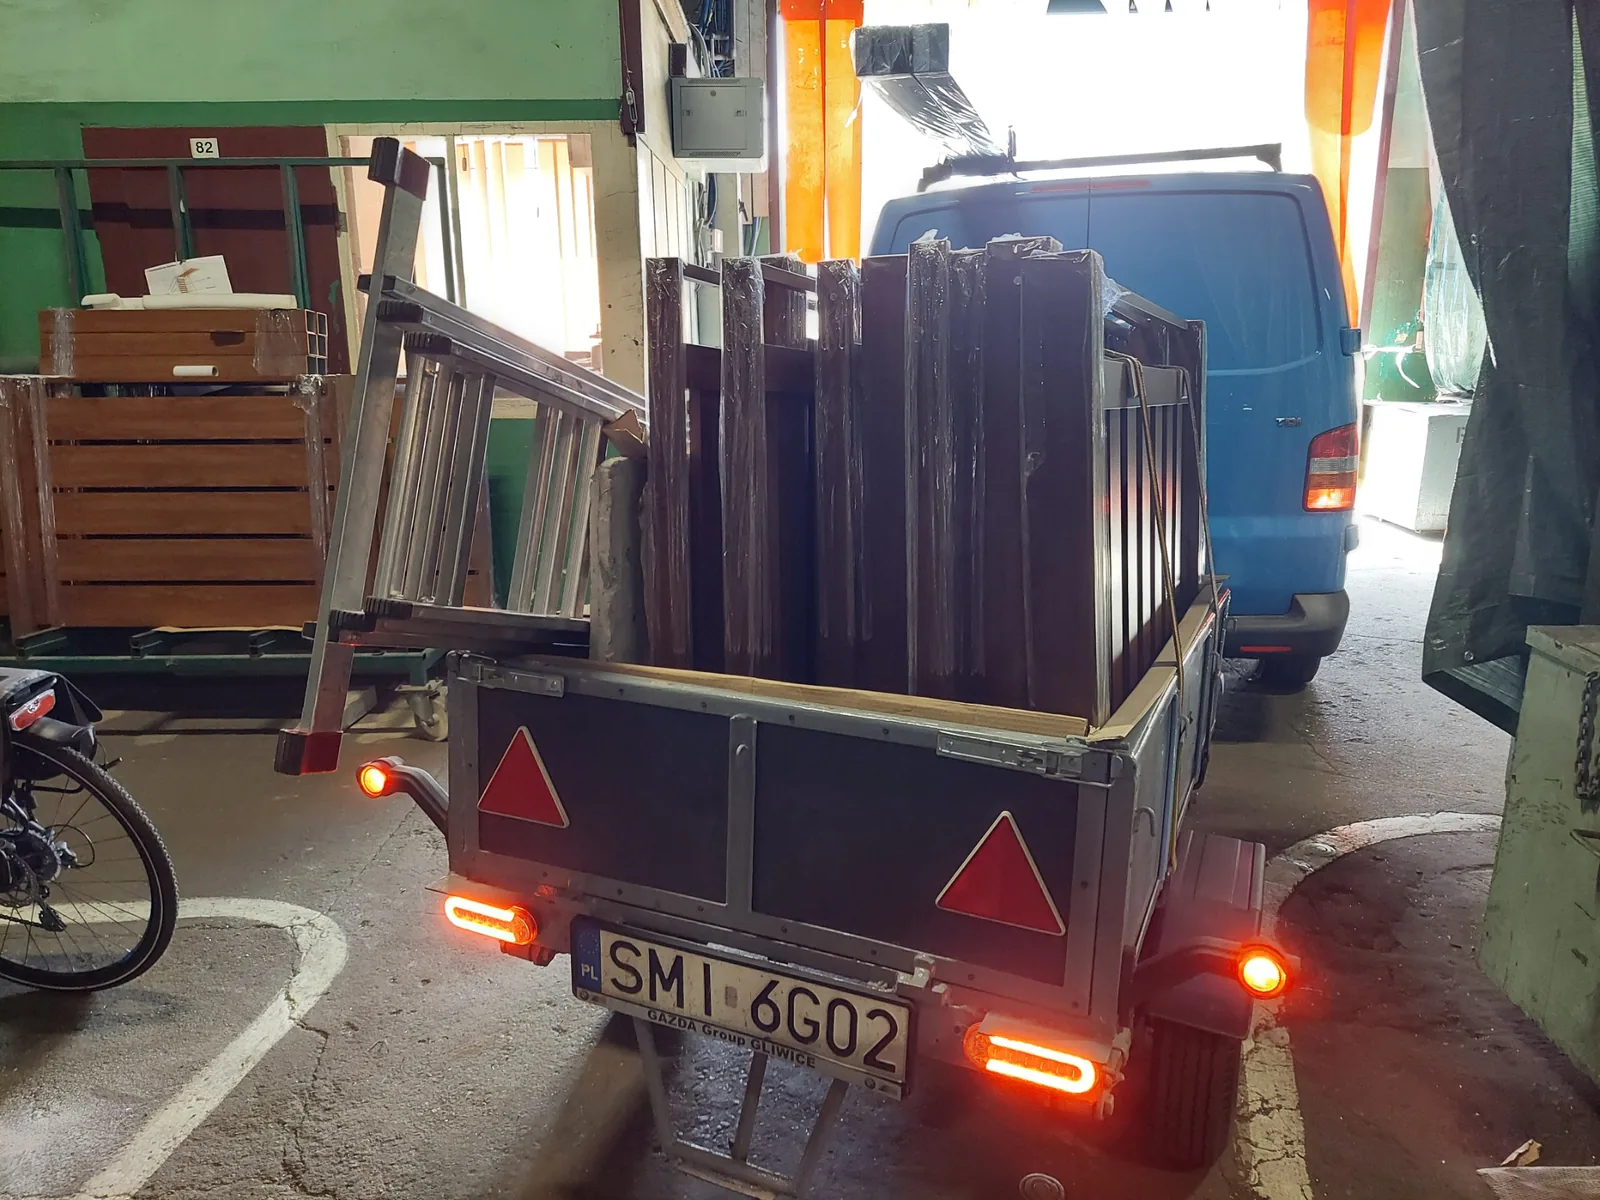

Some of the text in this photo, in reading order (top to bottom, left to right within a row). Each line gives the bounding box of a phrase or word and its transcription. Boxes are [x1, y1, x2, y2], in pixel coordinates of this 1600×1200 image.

[195, 141, 214, 154] 82
[581, 963, 599, 981] PL
[609, 940, 899, 1074] SMI 6G02
[647, 1010, 816, 1069] GAZDA Group GLIWICE
